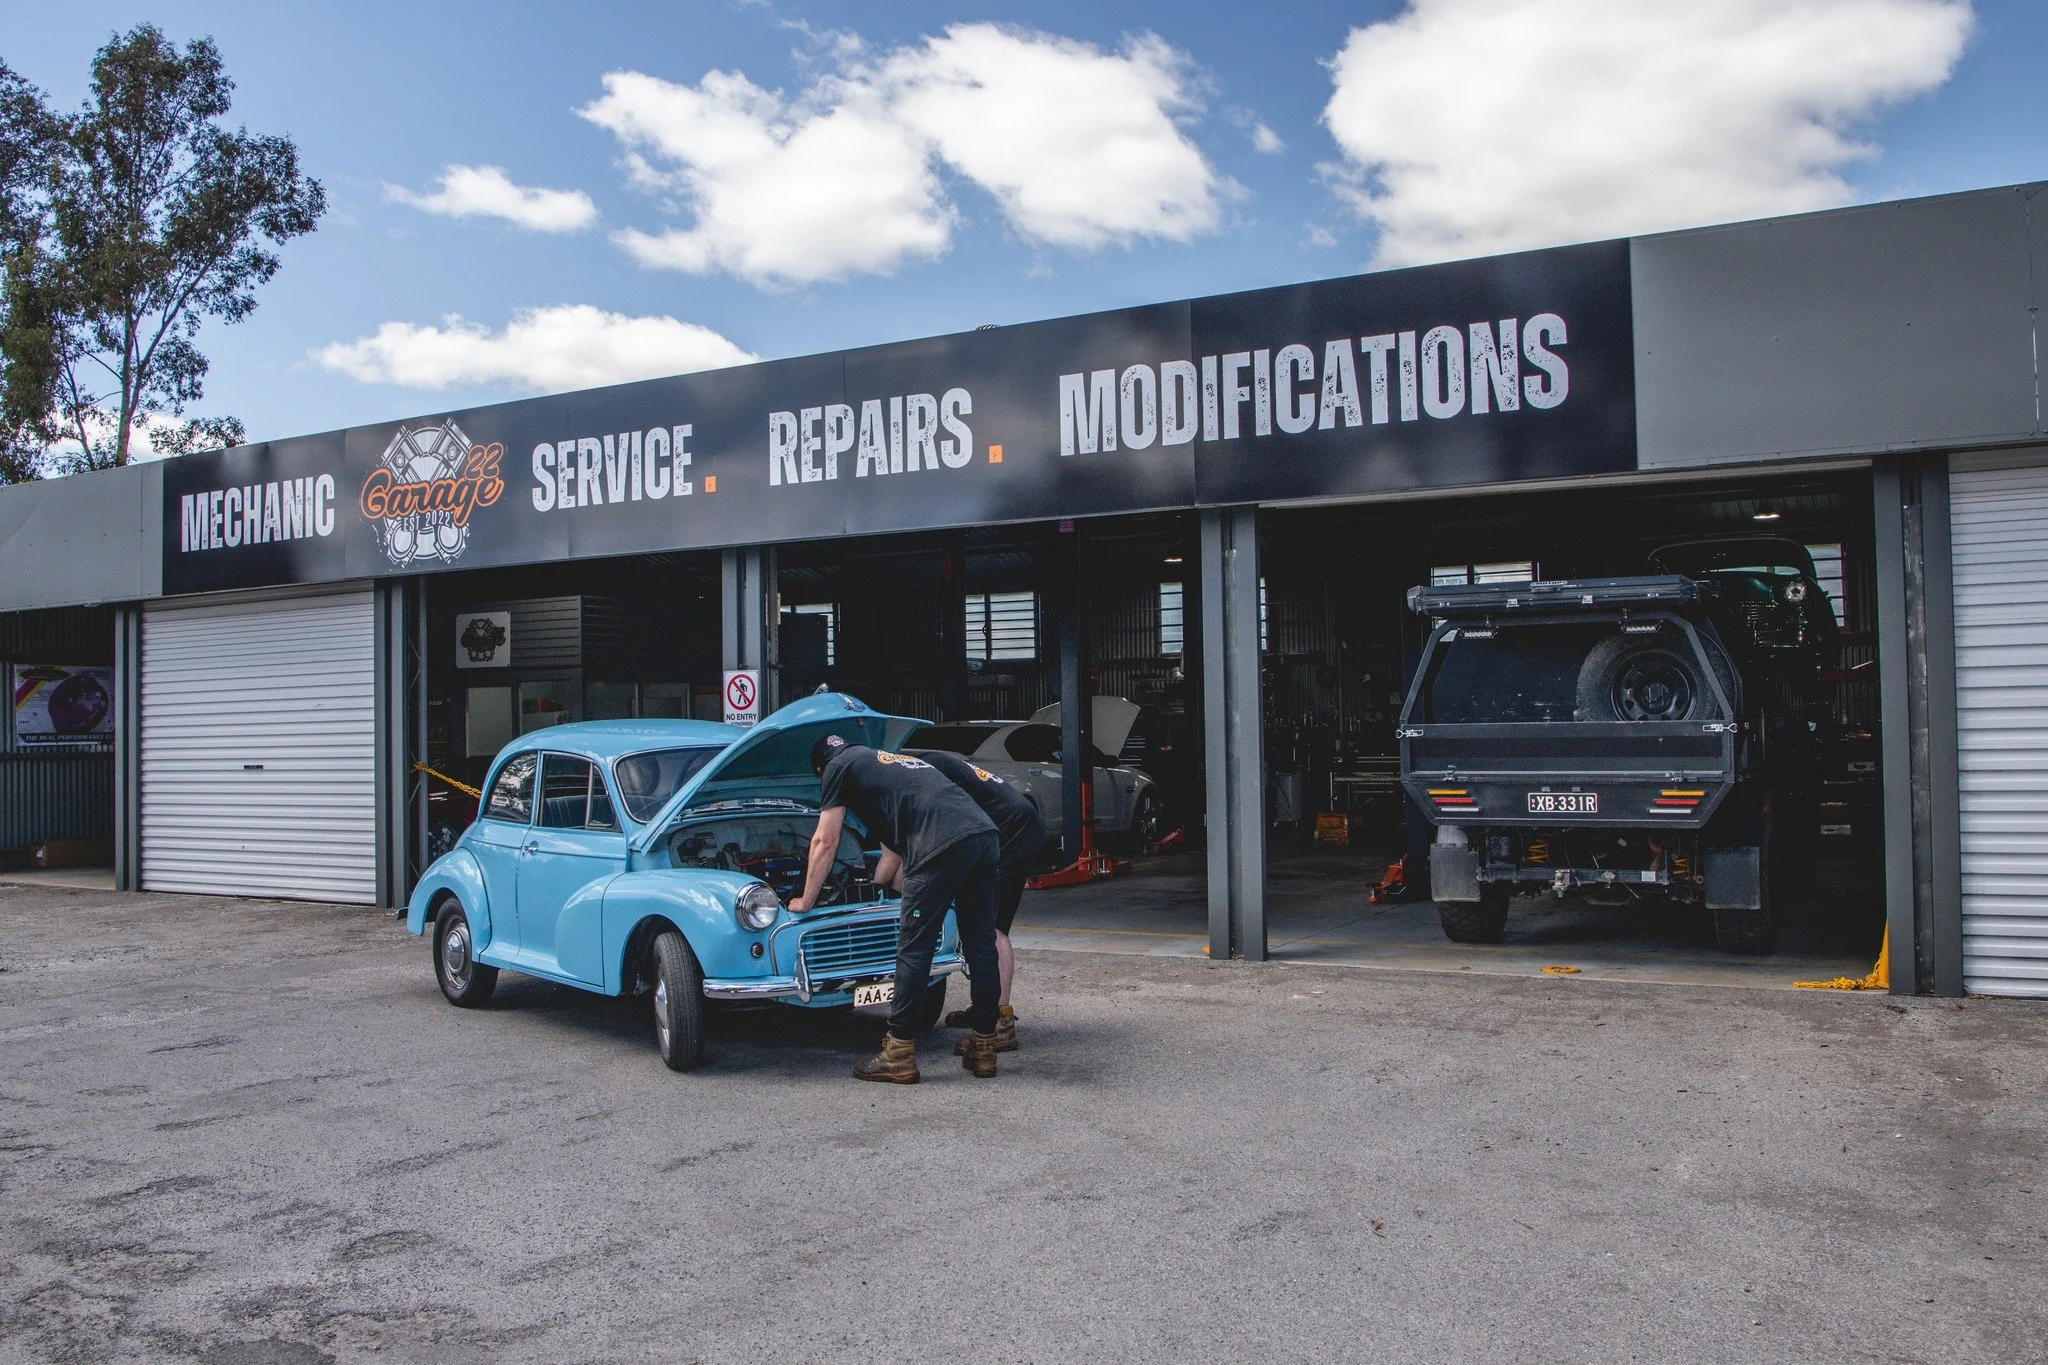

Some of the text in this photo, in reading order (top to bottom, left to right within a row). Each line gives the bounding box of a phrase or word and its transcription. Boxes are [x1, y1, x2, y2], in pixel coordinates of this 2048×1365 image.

[1059, 313, 1569, 456] MODIFICATIONS
[465, 442, 504, 481] 22
[181, 473, 335, 553] MECHANIC
[361, 468, 505, 527] Garage
[403, 509, 451, 532] EST 2022
